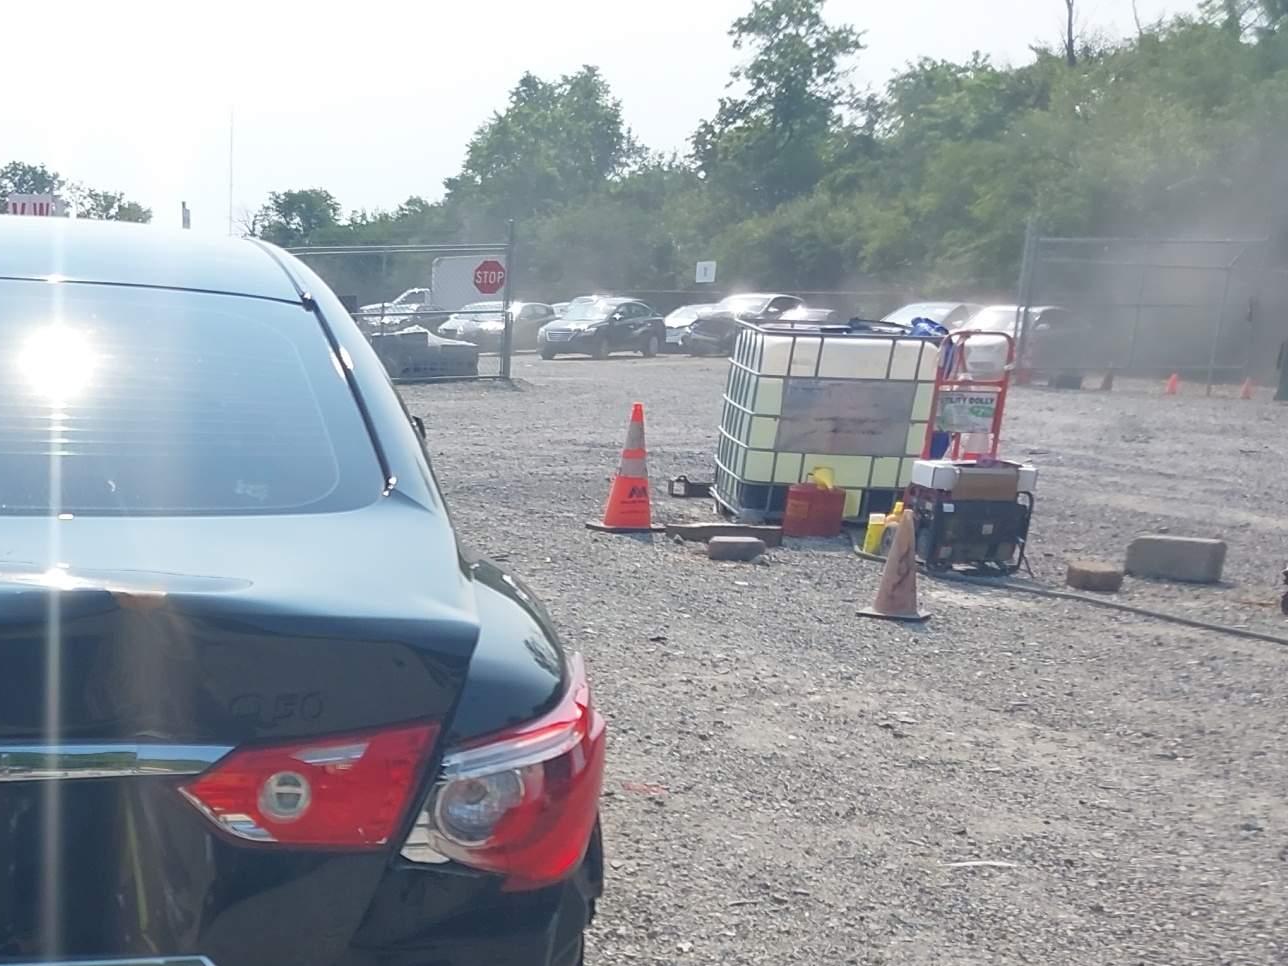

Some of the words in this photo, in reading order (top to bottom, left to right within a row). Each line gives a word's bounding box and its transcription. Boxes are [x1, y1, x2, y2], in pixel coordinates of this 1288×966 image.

[475, 270, 505, 285] STOP
[968, 396, 995, 405] DOLLY
[229, 689, 324, 729] Q50
